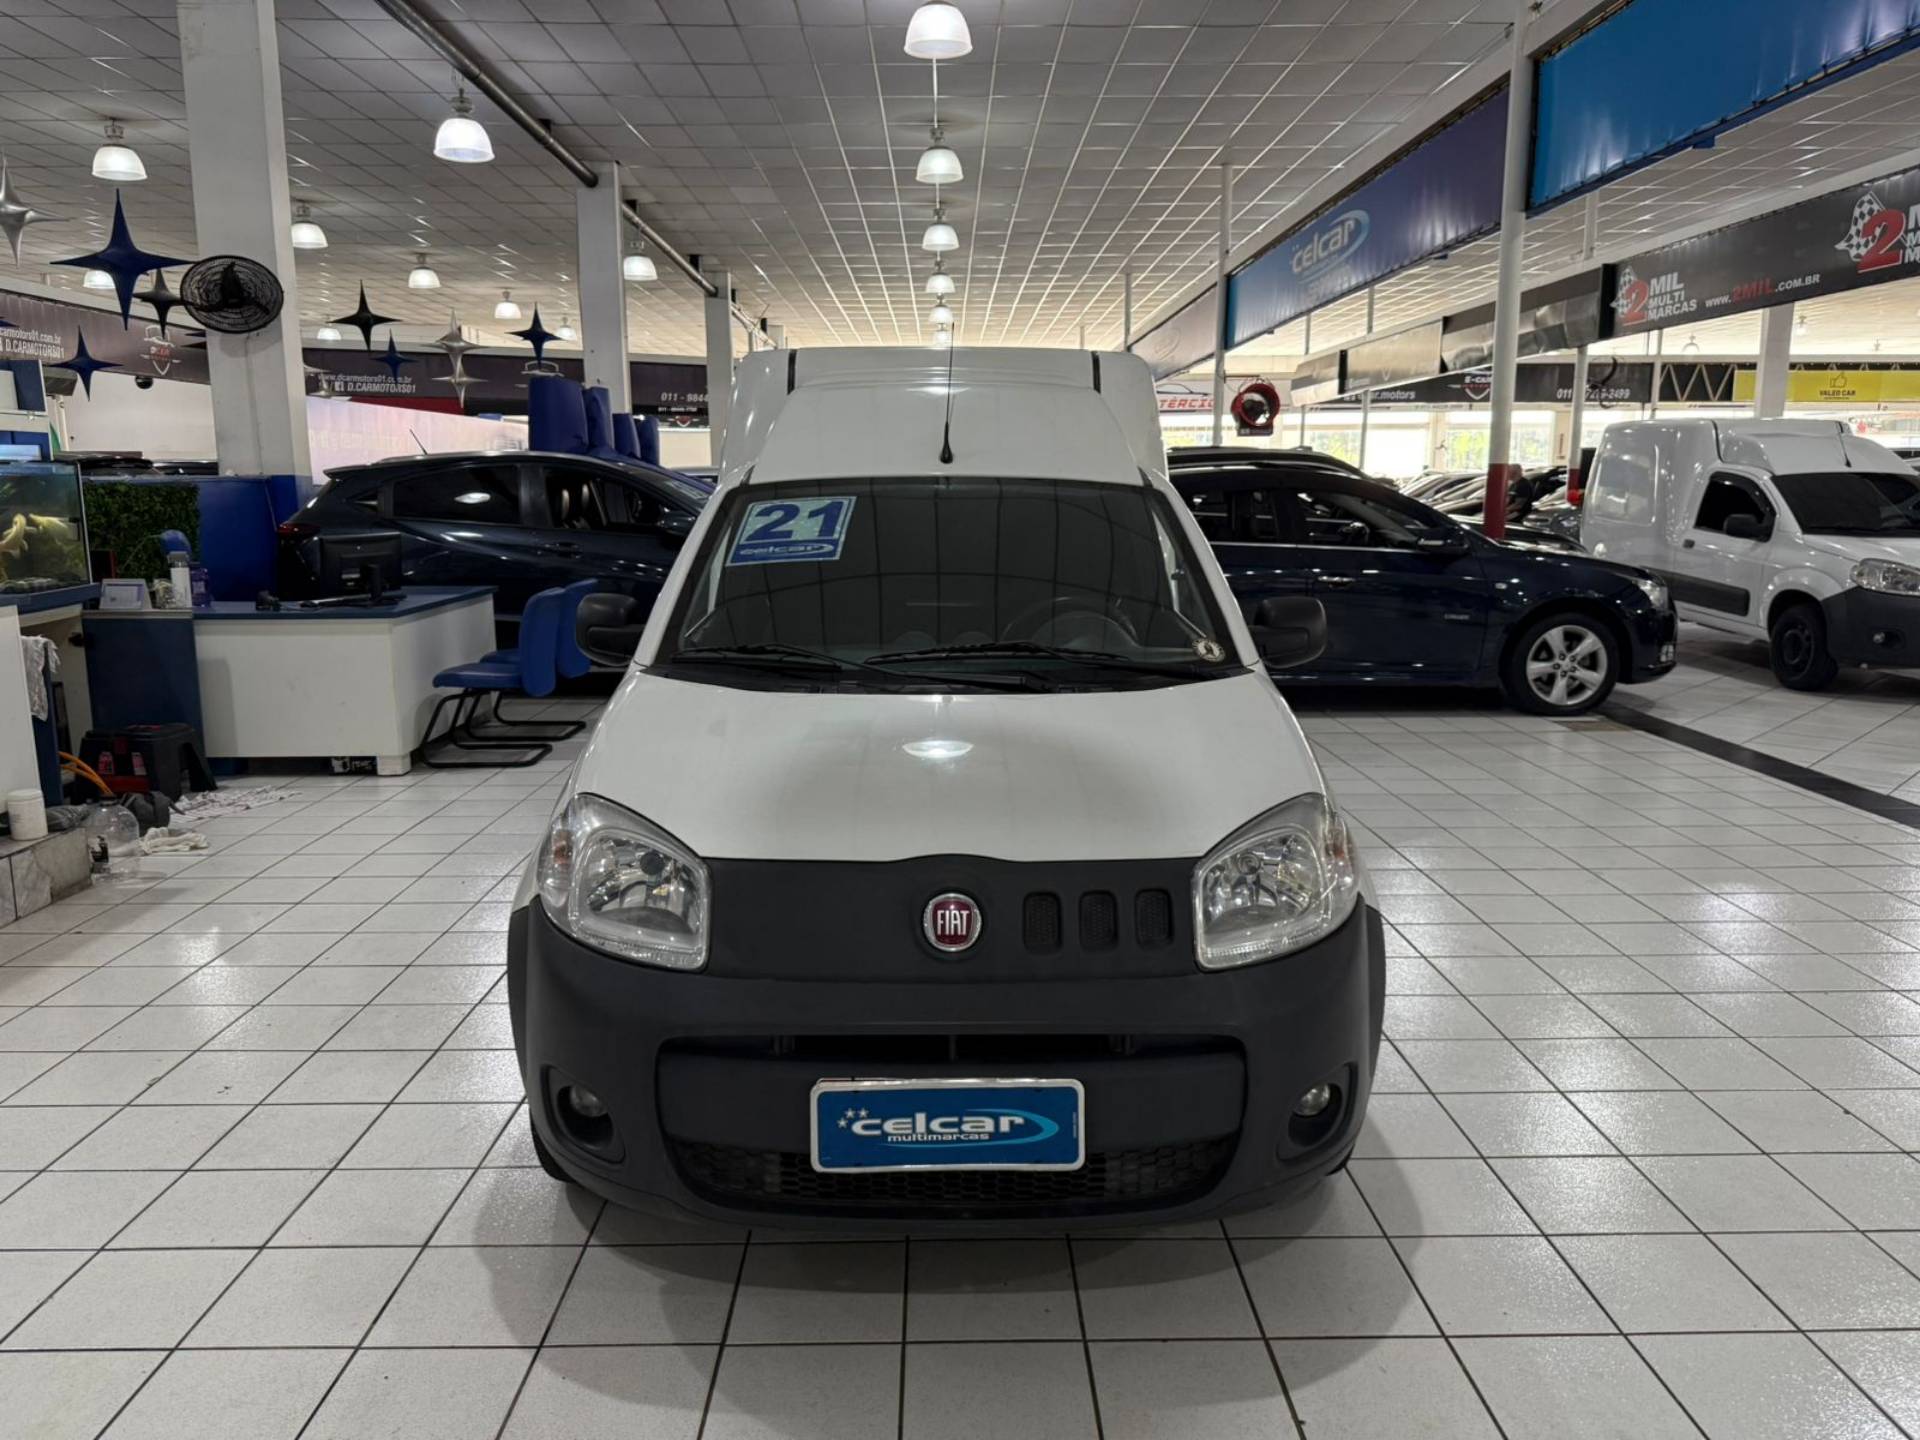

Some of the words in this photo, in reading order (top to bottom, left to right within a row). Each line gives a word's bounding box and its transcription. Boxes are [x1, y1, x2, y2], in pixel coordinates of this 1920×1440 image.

[1293, 218, 1355, 273] celcar
[1856, 208, 1905, 273] 2
[1622, 280, 1648, 326] 2
[1650, 272, 1685, 296] MIL
[1648, 300, 1698, 321] MARCAS
[1649, 290, 1685, 307] MULTI
[660, 392, 678, 401] 011
[1556, 388, 1574, 399] 011
[745, 500, 845, 541] 21
[936, 909, 971, 935] FIAT
[851, 1112, 1025, 1136] celcar
[887, 1132, 990, 1143] multimarcas
